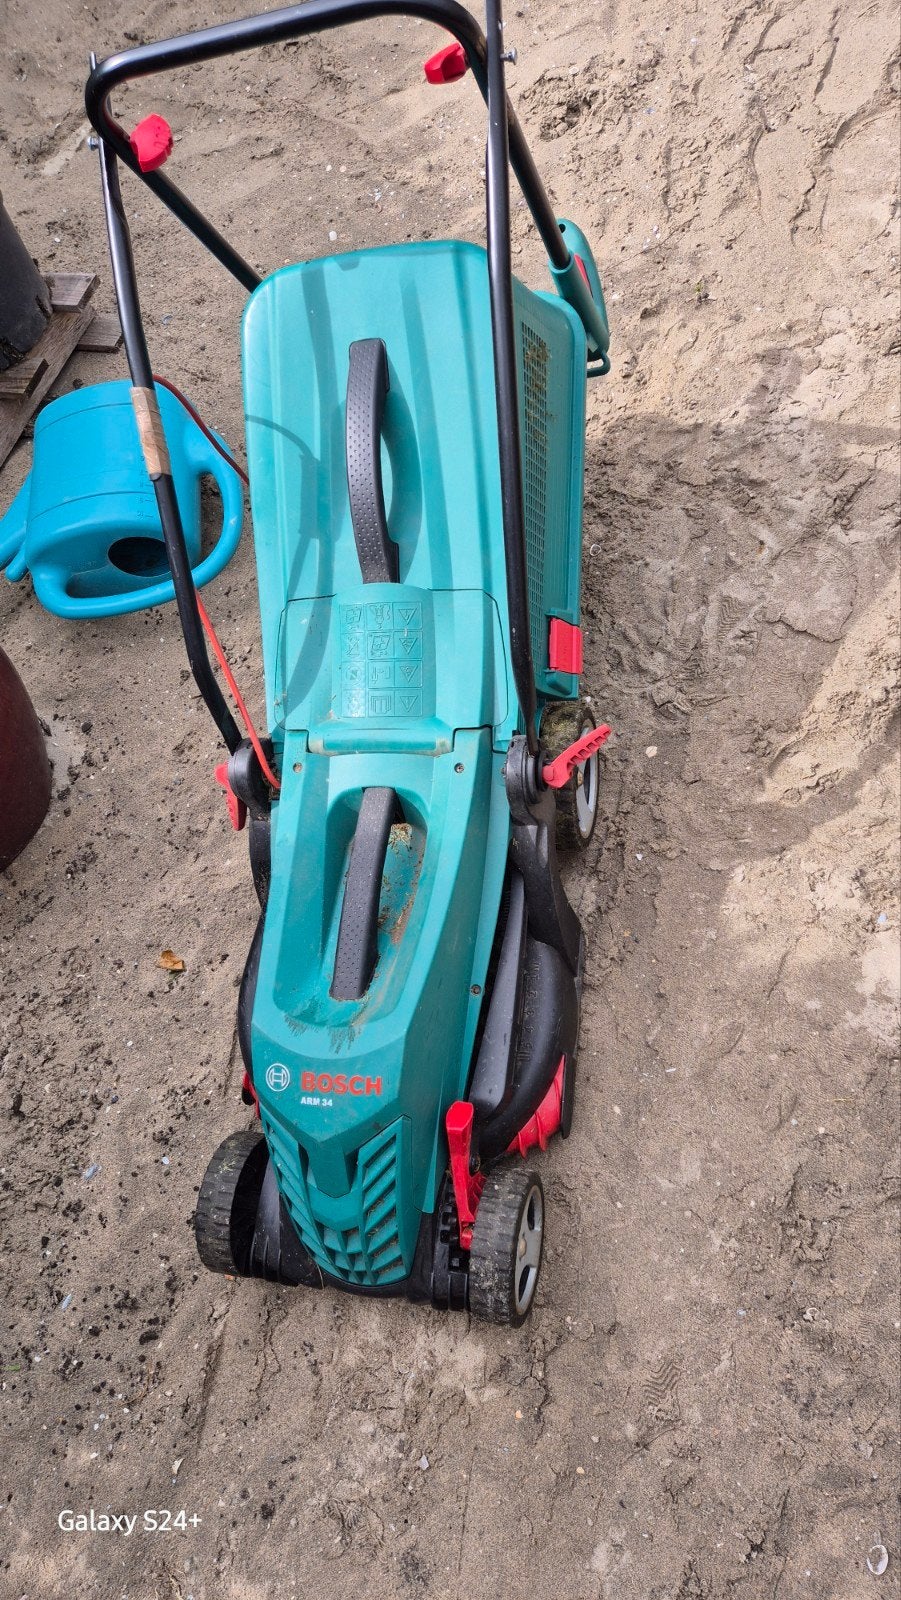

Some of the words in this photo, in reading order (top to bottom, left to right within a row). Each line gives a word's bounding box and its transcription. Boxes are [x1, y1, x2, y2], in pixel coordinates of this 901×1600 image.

[301, 1071, 382, 1096] BOSCH
[300, 1097, 320, 1106] ARM
[322, 1098, 333, 1107] 34
